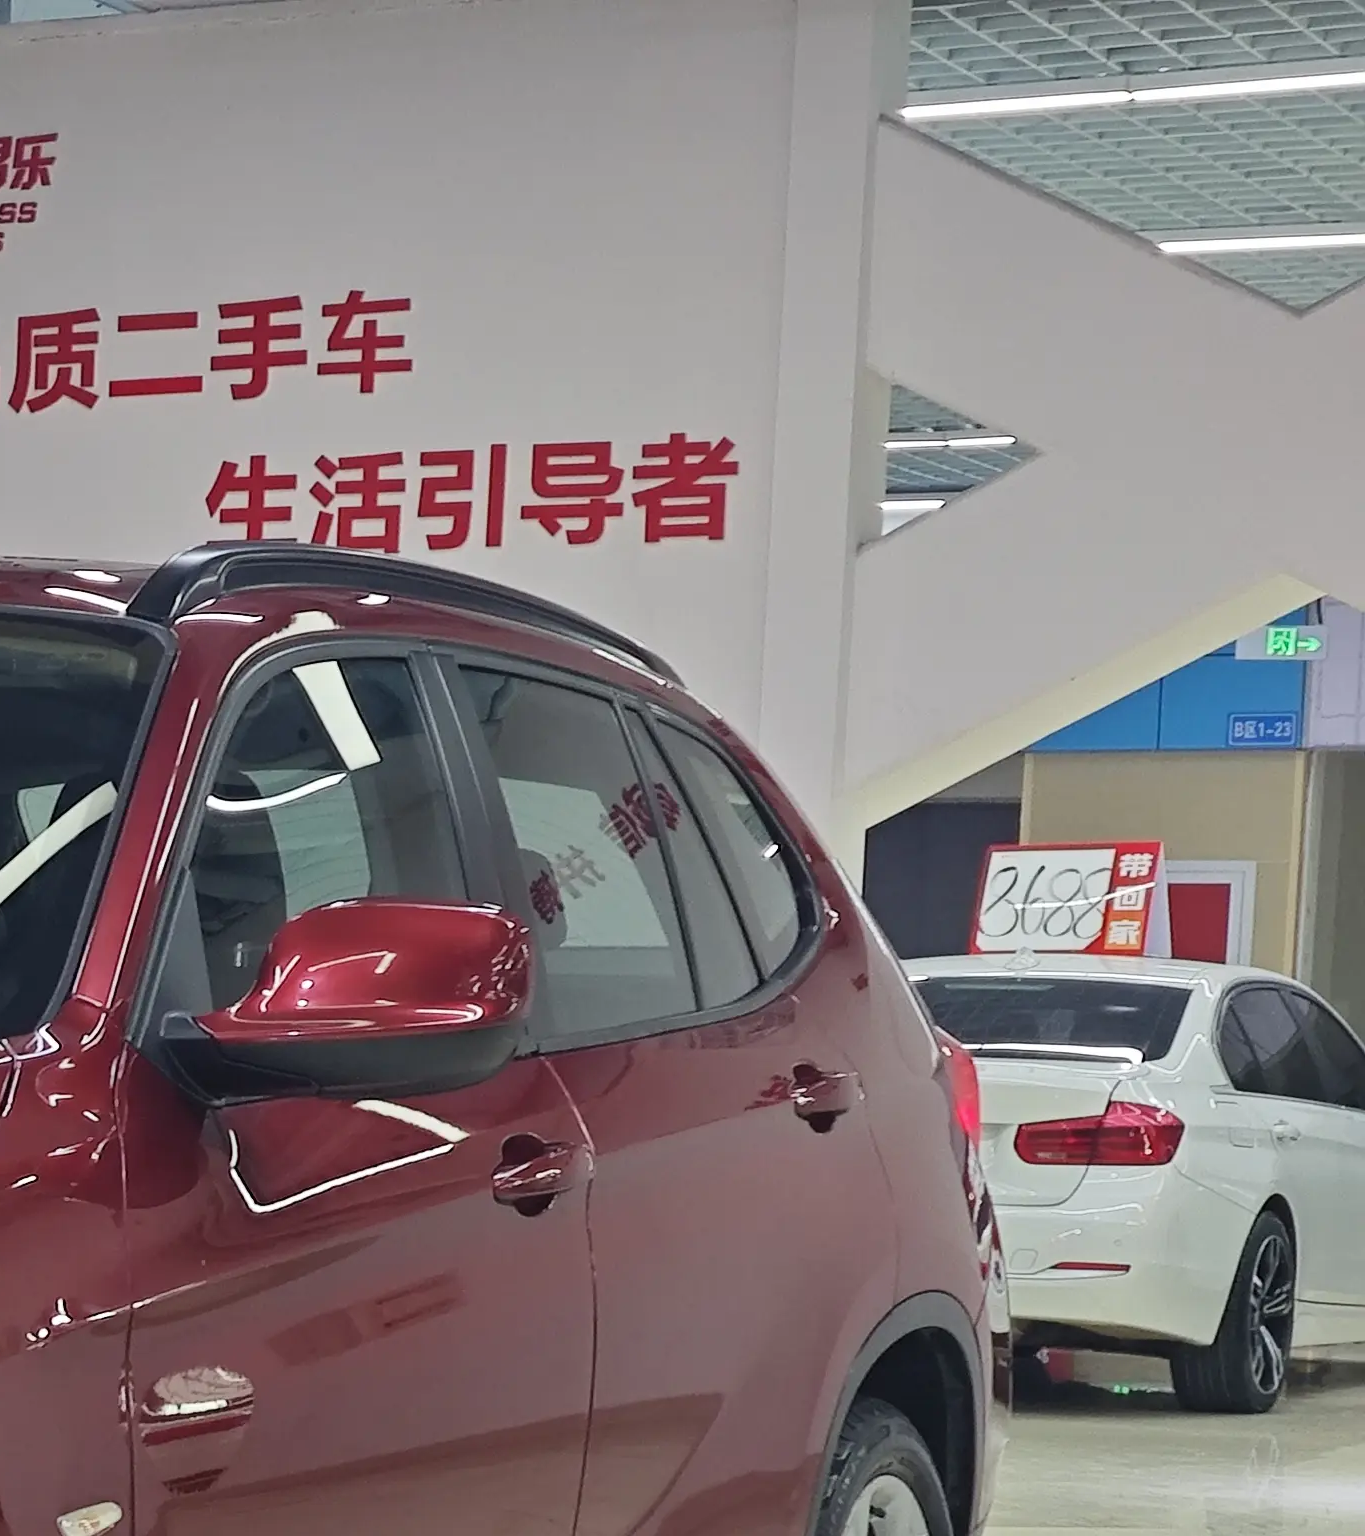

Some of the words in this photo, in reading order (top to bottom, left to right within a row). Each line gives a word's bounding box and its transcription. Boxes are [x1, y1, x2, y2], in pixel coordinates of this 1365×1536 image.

[204, 431, 740, 552] 生活引导者
[1108, 852, 1155, 946] 带回家
